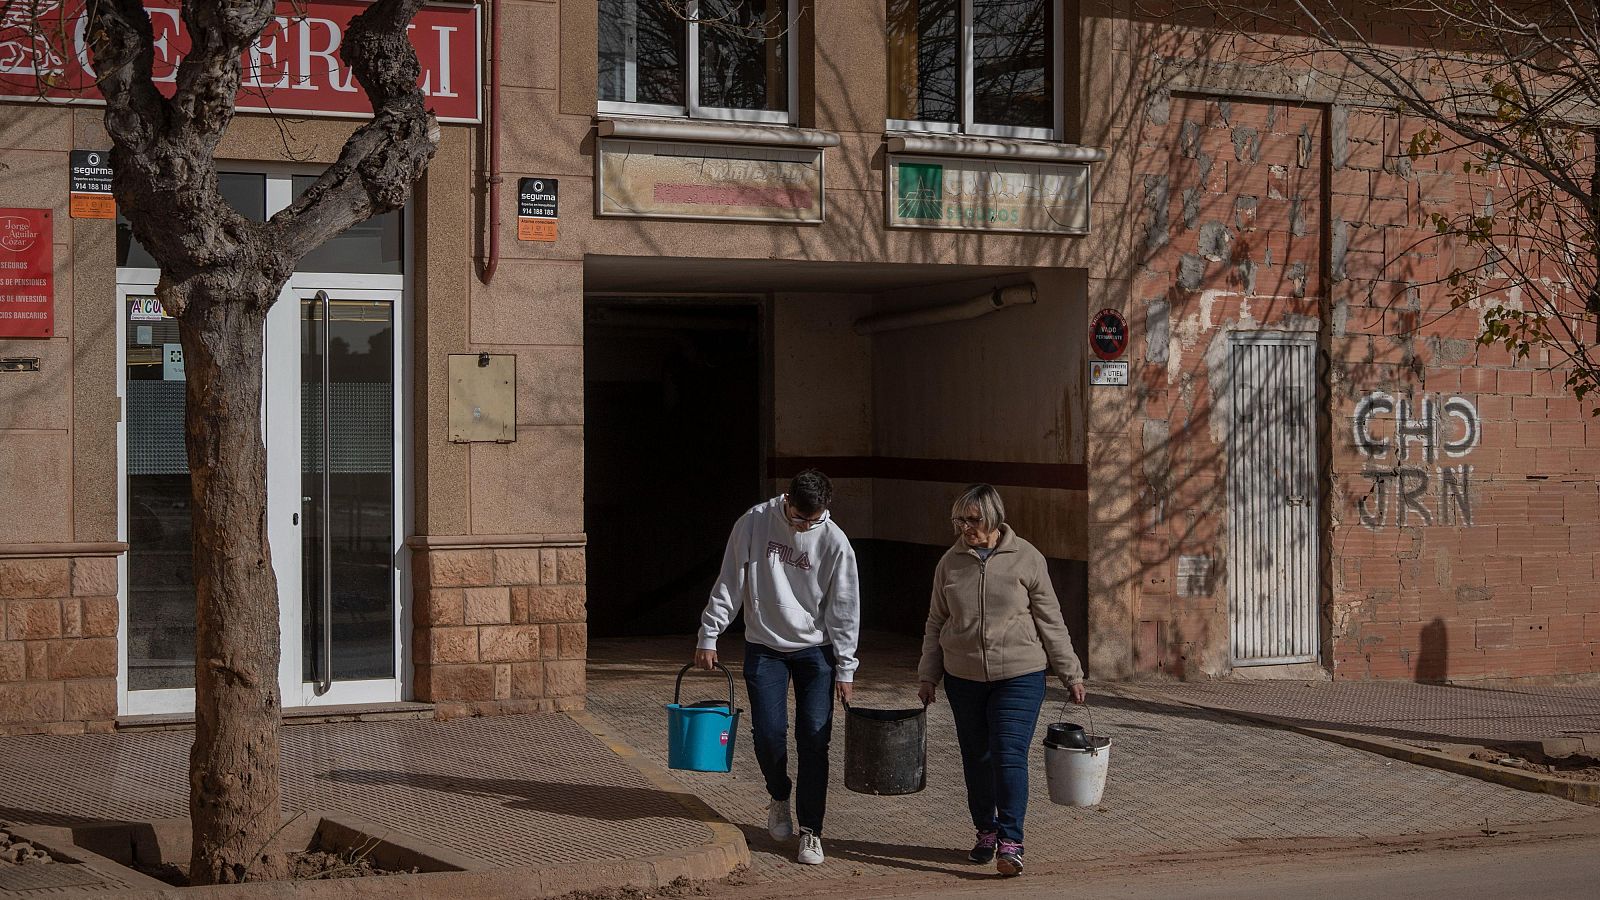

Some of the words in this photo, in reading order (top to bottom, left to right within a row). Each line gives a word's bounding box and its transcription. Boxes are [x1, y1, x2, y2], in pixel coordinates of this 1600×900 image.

[75, 182, 87, 190] 914
[521, 193, 556, 202] segurma
[946, 207, 1019, 224] SEGUROS
[4, 219, 30, 231] Jorge
[10, 230, 39, 239] Aguilar
[0, 261, 28, 270] SEGUROS
[5, 278, 14, 286] DE
[14, 278, 47, 287] PENSIONES
[6, 295, 15, 303] DE
[15, 293, 48, 303] INVERSIÓN
[13, 311, 48, 320] BANCARIOS
[767, 541, 812, 570] FILA
